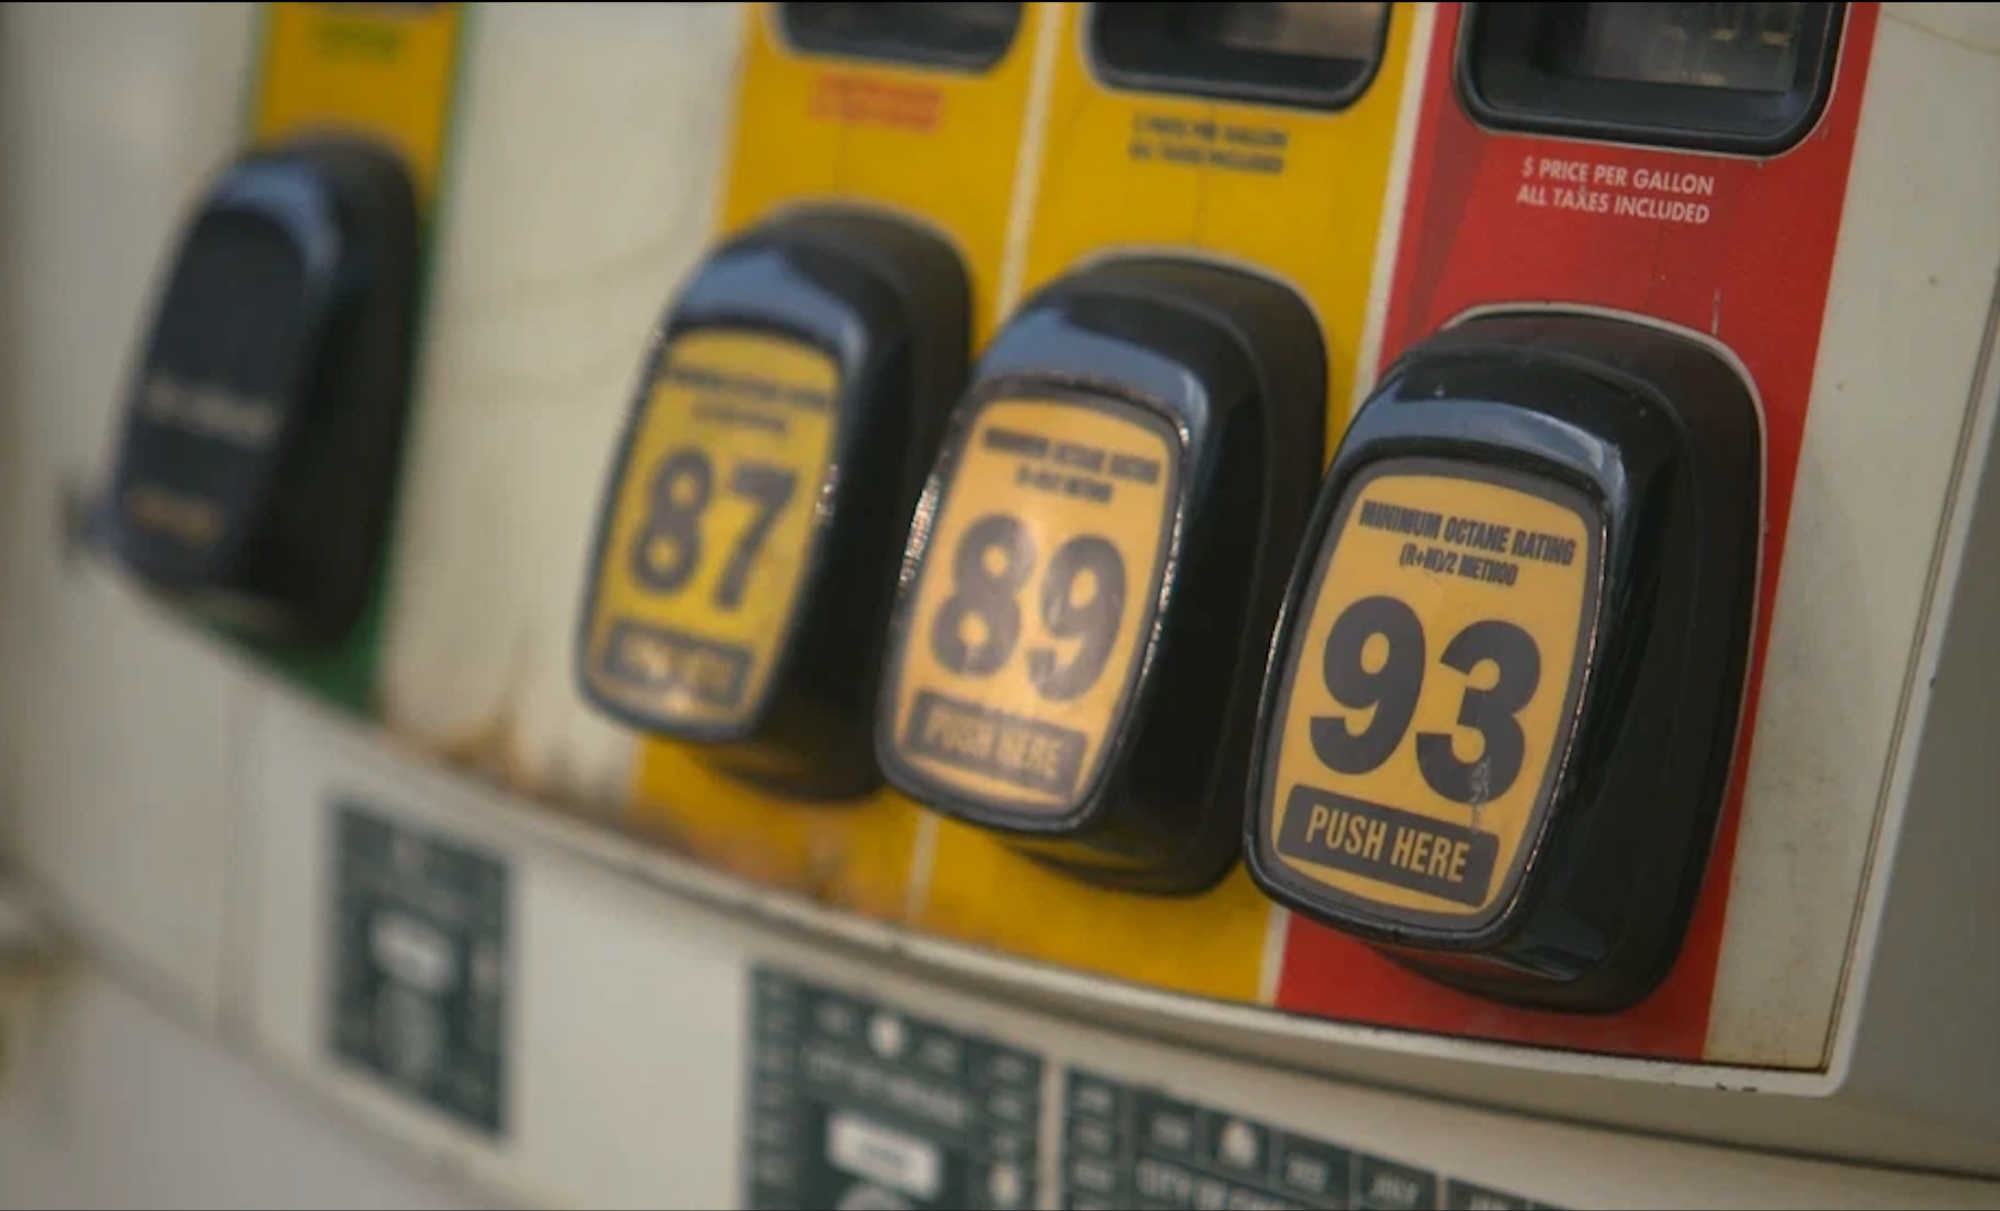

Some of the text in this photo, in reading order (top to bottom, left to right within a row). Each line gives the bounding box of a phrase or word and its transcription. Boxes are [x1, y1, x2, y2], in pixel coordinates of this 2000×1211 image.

[1517, 185, 1710, 224] ALL TAXES INCLUDED
[1522, 156, 1714, 195] $ PRICE PER GALLON
[630, 445, 798, 610] 87
[1359, 500, 1577, 566] MINIMUM OCTANE RATING
[1458, 554, 1519, 586] METHOD
[930, 512, 1127, 702] 89
[1309, 595, 1541, 803] 93
[997, 729, 1063, 781] HERE
[1305, 804, 1471, 883] PUSH HERE
